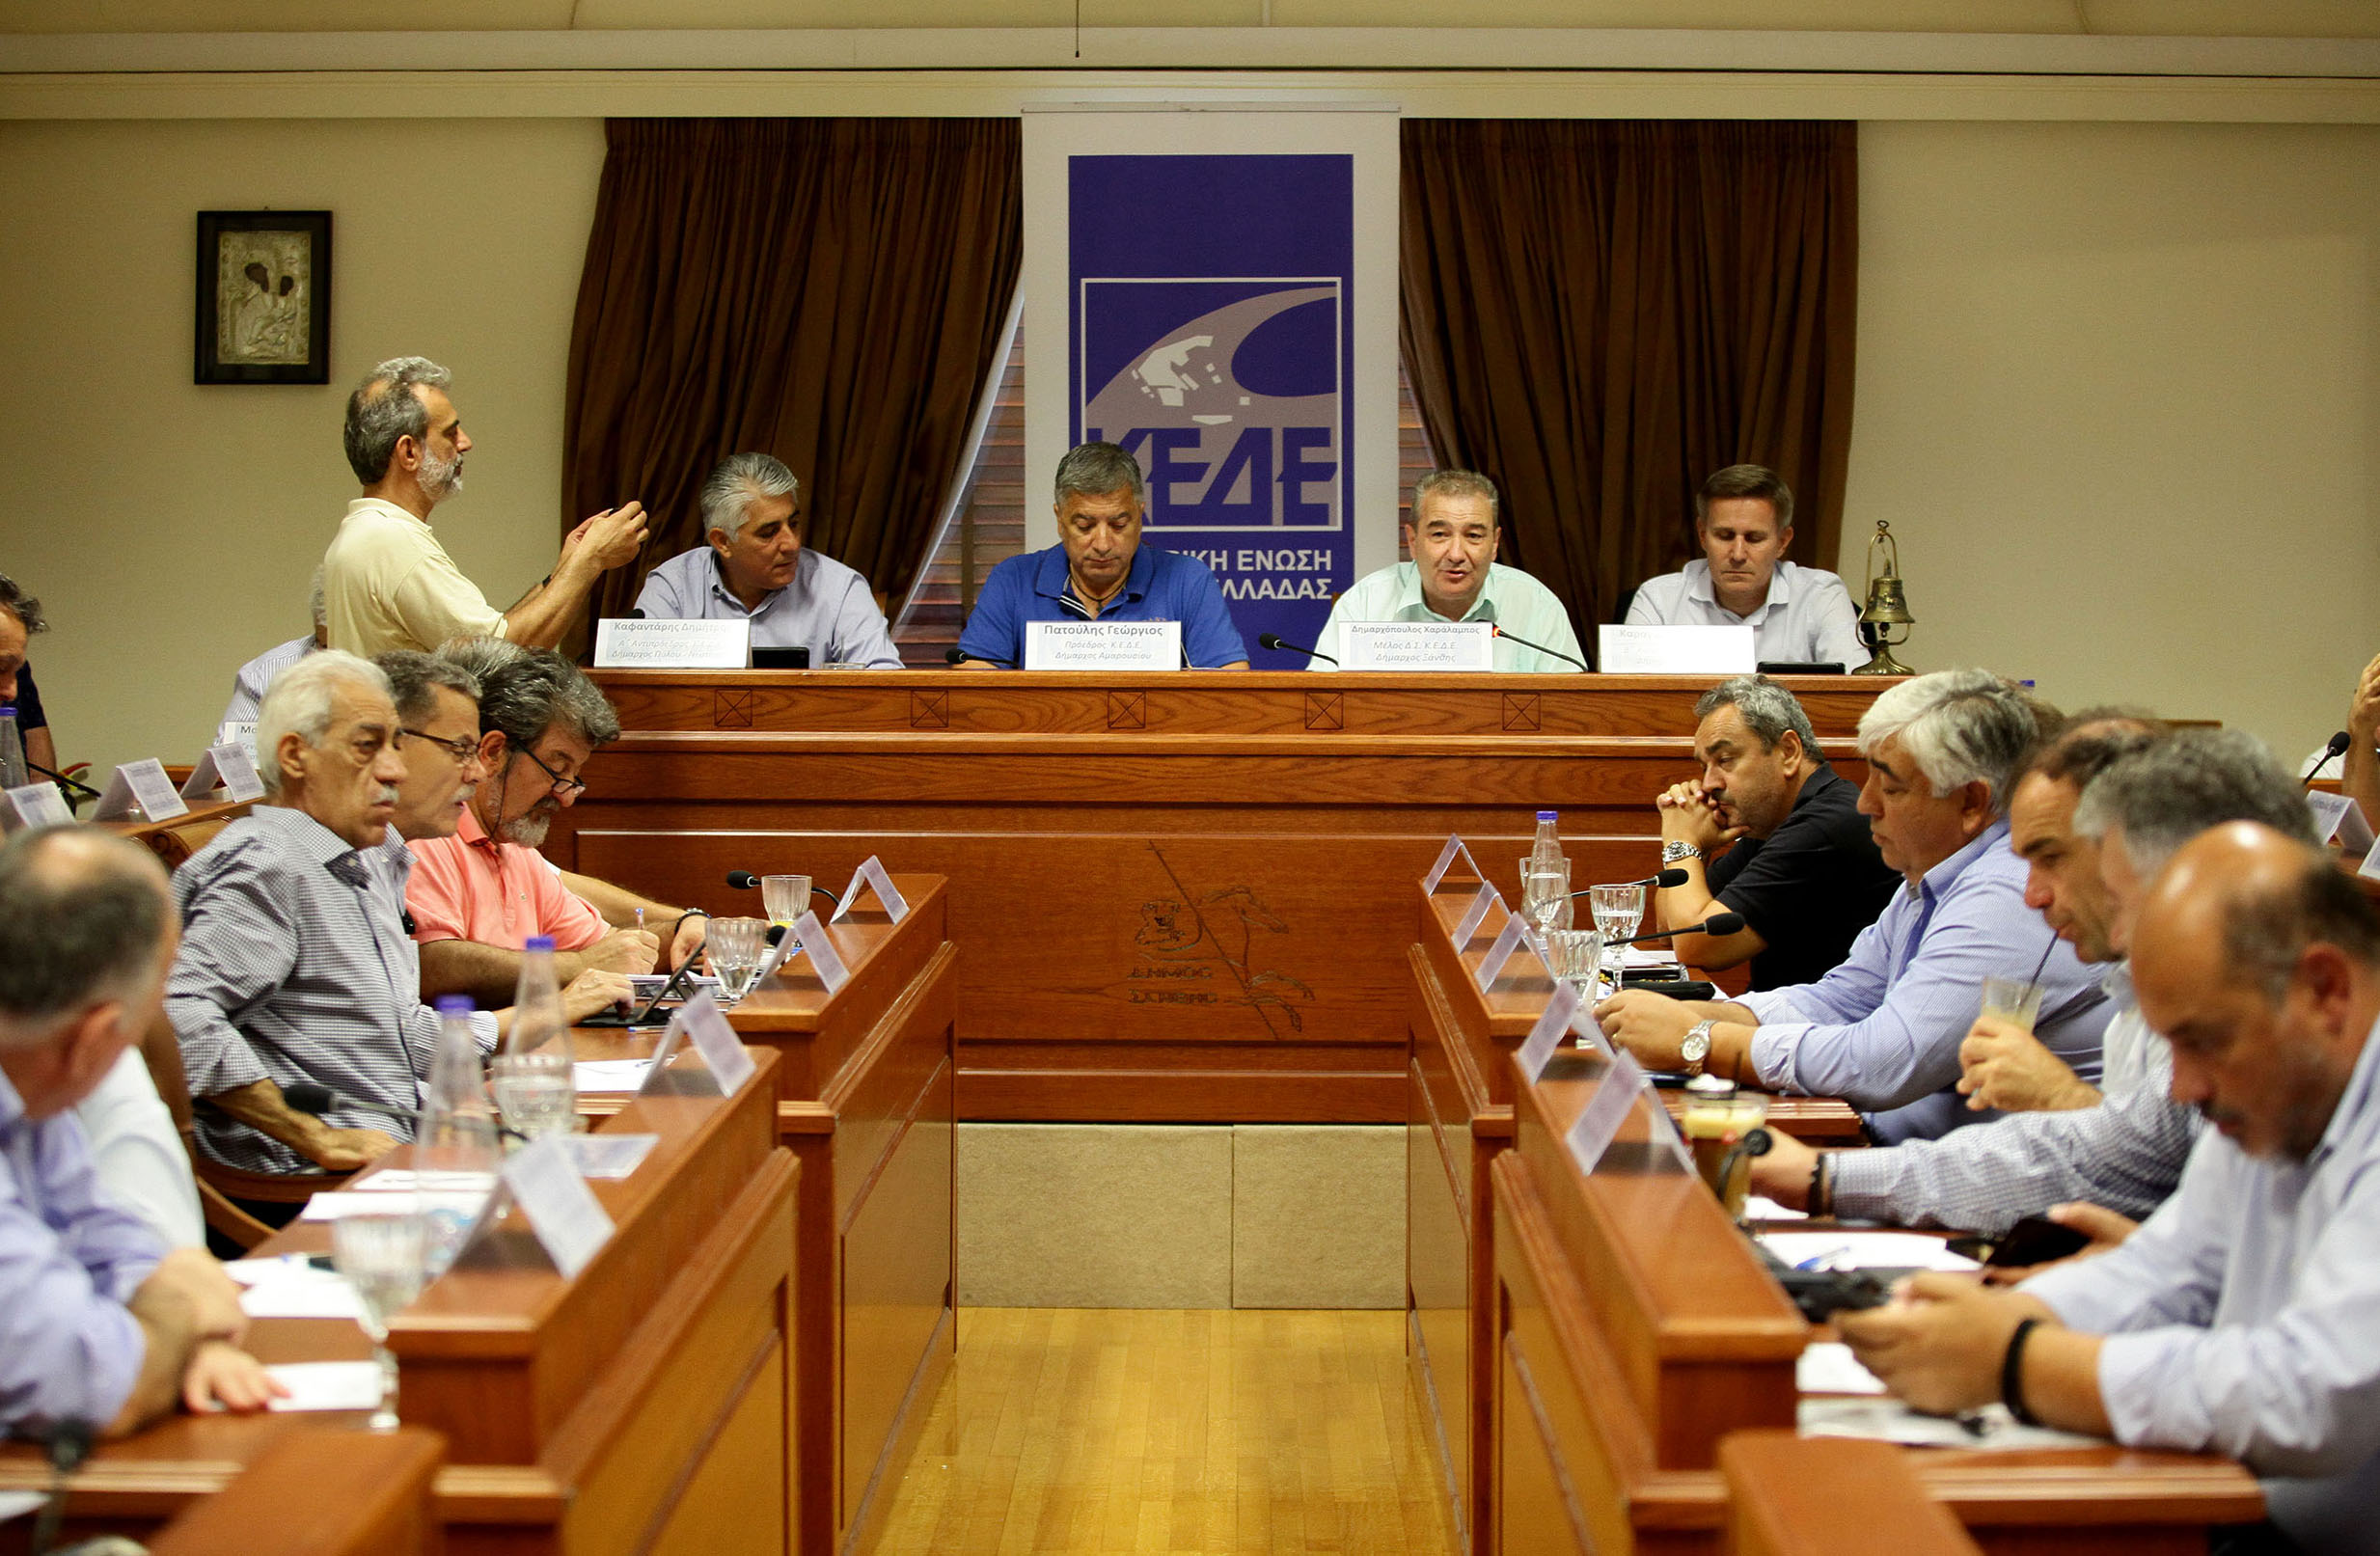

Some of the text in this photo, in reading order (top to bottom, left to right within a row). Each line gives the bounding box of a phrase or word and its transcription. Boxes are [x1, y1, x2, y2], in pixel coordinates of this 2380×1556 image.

[1237, 550, 1331, 571] ΕΝΩΣΗ
[1216, 578, 1332, 600] ΛΛΑΔΑΣ
[1044, 625, 1163, 637] Πατούλης Γεώργιος
[1351, 625, 1480, 635] Δημαρχόπουλος Χαράλαμπος
